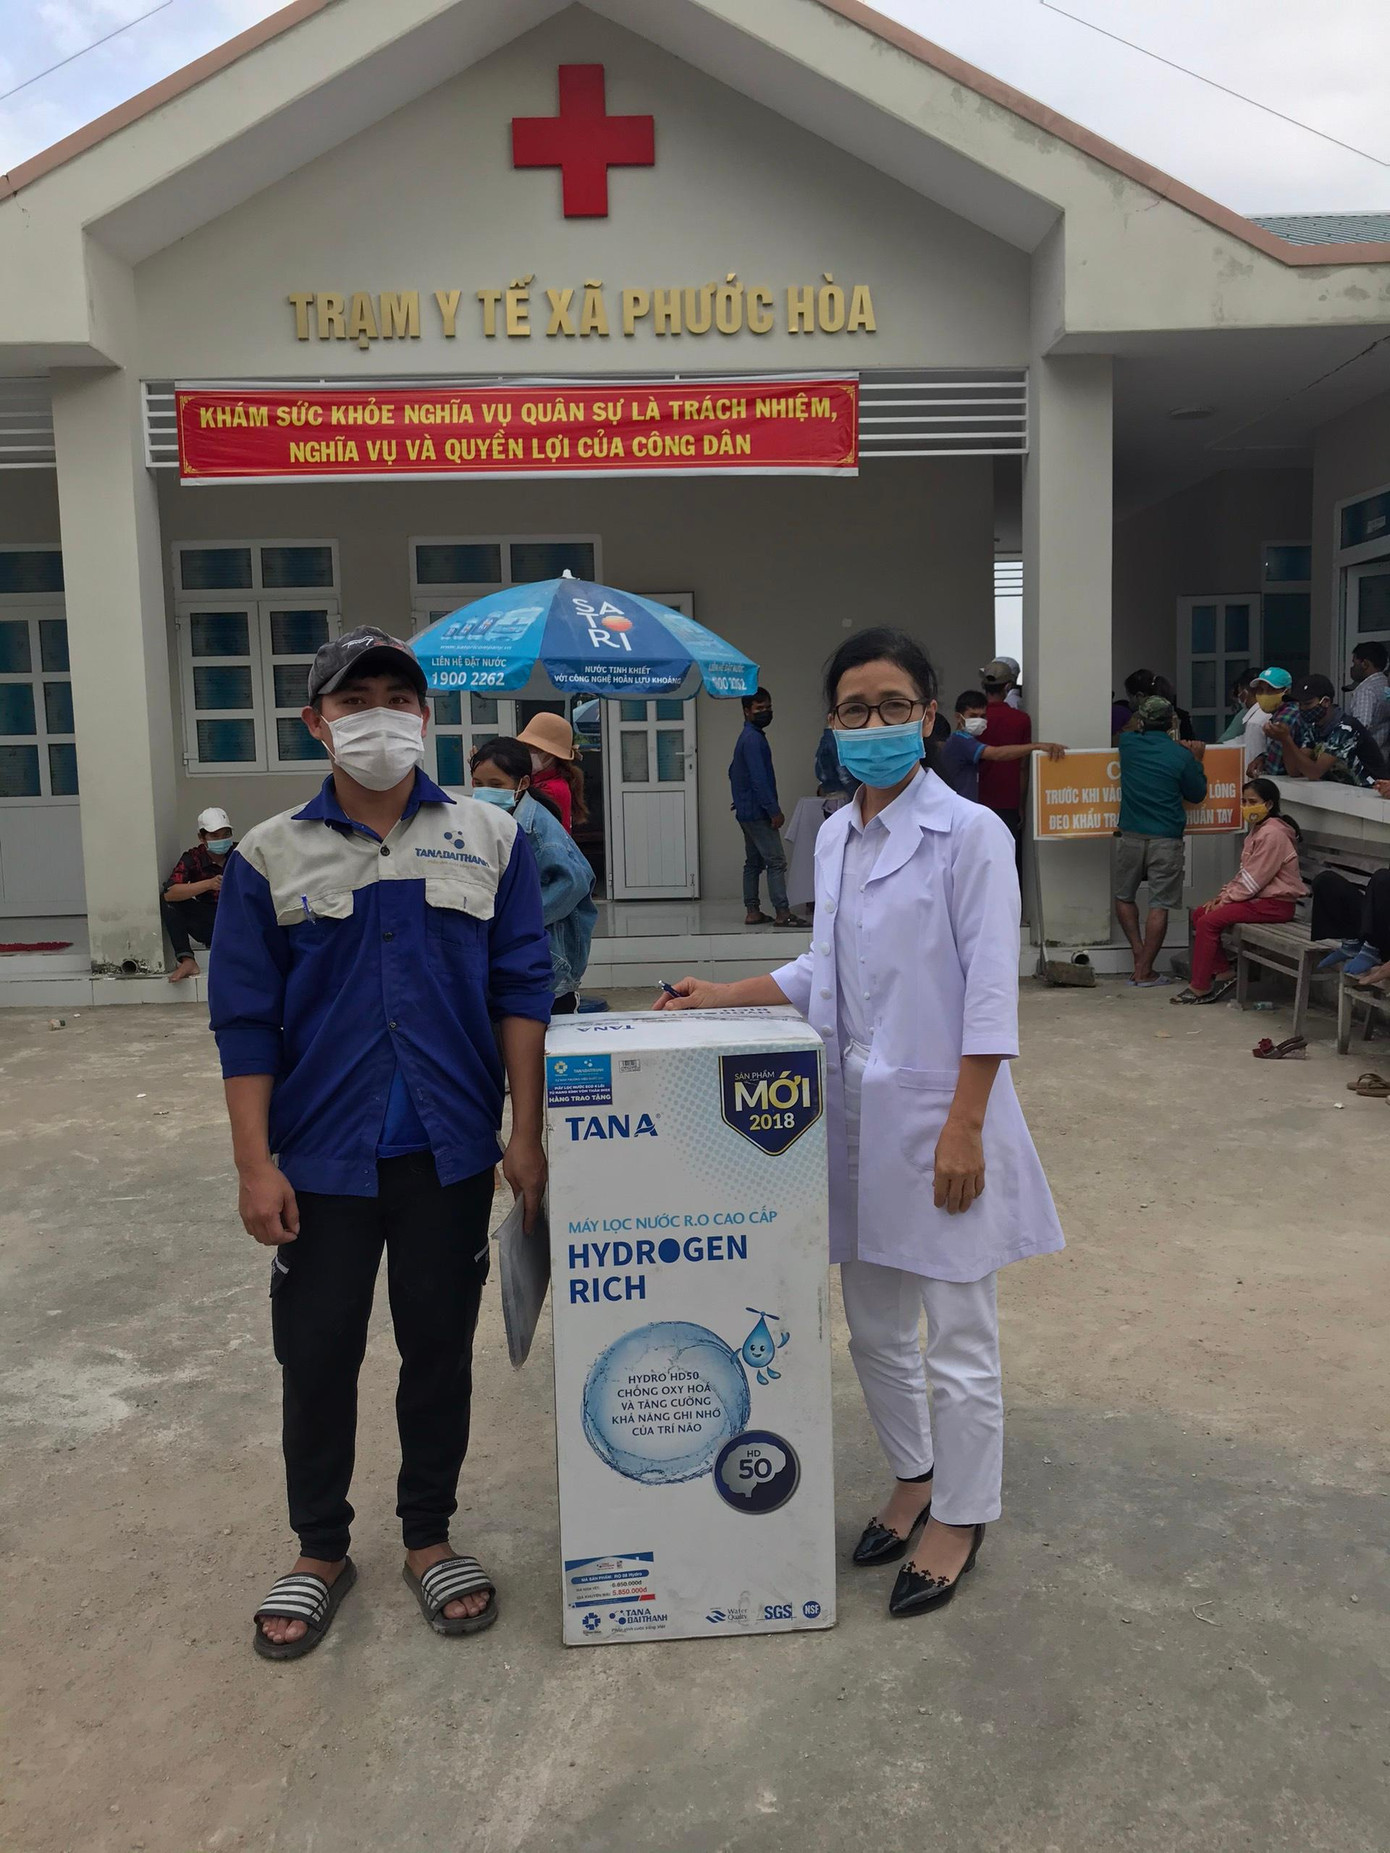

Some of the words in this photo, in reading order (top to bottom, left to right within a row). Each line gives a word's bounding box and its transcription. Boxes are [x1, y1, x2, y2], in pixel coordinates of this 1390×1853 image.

[288, 291, 421, 350] TRẠM
[435, 288, 462, 338] Y
[476, 273, 535, 338] TẾ
[545, 279, 609, 337] XÃ
[622, 272, 774, 337] PHƯỚC
[787, 272, 877, 335] HÒA
[200, 401, 268, 428] KHÁM
[276, 399, 323, 427] SỨC
[331, 397, 395, 426] KHỎE
[404, 399, 474, 425] NGHĨA
[482, 402, 512, 427] VỤ
[521, 397, 584, 426] QUÂN
[592, 398, 624, 425] SỰ
[631, 396, 661, 421] LÀ
[668, 395, 746, 420] TRÁCH
[755, 392, 838, 422] NHIỆM,
[290, 435, 359, 463] NGHĨA
[367, 439, 397, 465] VỤ
[406, 433, 436, 461] VÀ
[445, 429, 523, 463] QUYỀN
[532, 433, 570, 463] LỢI
[577, 429, 625, 458] CỦA
[631, 430, 695, 457] CÔNG
[703, 429, 751, 455] DÂN
[431, 655, 450, 667] LIÊN
[452, 655, 463, 668] HỆ
[465, 655, 480, 668] ĐẶT
[482, 655, 507, 667] NƯỚC
[585, 664, 607, 673] NƯỚC
[609, 666, 627, 674] TINH
[629, 665, 651, 675] KHIẾT
[432, 671, 467, 686] 1900
[470, 671, 505, 686] 2262
[569, 673, 589, 683] CÔNG
[591, 674, 611, 684] NGHỆ
[1045, 786, 1079, 804] TRƯỚC
[1082, 787, 1099, 803] KHI
[1209, 779, 1236, 799] LÒNG
[1049, 814, 1068, 830] ĐEO
[1073, 808, 1101, 829] KHẨU
[1216, 808, 1233, 824] TAY
[570, 1094, 590, 1102] TRAO
[734, 1070, 811, 1112] MỚI
[565, 1113, 658, 1141] TANA
[749, 1112, 796, 1131] 2018
[568, 1217, 599, 1234] MÁY
[603, 1217, 632, 1234] LỌC
[636, 1212, 681, 1229] NƯỚC
[684, 1214, 710, 1226] R.O
[713, 1211, 745, 1225] CAO
[749, 1205, 778, 1224] CẤP
[568, 1234, 748, 1270] HYDROGEN
[569, 1274, 646, 1304] RICH
[628, 1373, 667, 1385] HYDRO
[670, 1371, 700, 1381] HD50
[617, 1384, 658, 1398] CHỐNG
[661, 1385, 684, 1395] OXY
[687, 1381, 711, 1394] HOÁ
[621, 1399, 634, 1411] VÀ
[638, 1398, 667, 1410] TĂNG
[670, 1396, 711, 1408] CƯỜNG
[612, 1412, 635, 1425] KHẢ
[638, 1411, 670, 1423] NĂNG
[673, 1411, 693, 1420] GHI
[696, 1407, 721, 1419] NHỚ
[632, 1425, 654, 1437] CỦA
[657, 1422, 675, 1434] TRÍ
[678, 1421, 702, 1433] NÃO
[739, 1458, 772, 1480] 50
[626, 1608, 651, 1617] TANA
[764, 1604, 792, 1620] SGS
[804, 1604, 819, 1615] NSF
